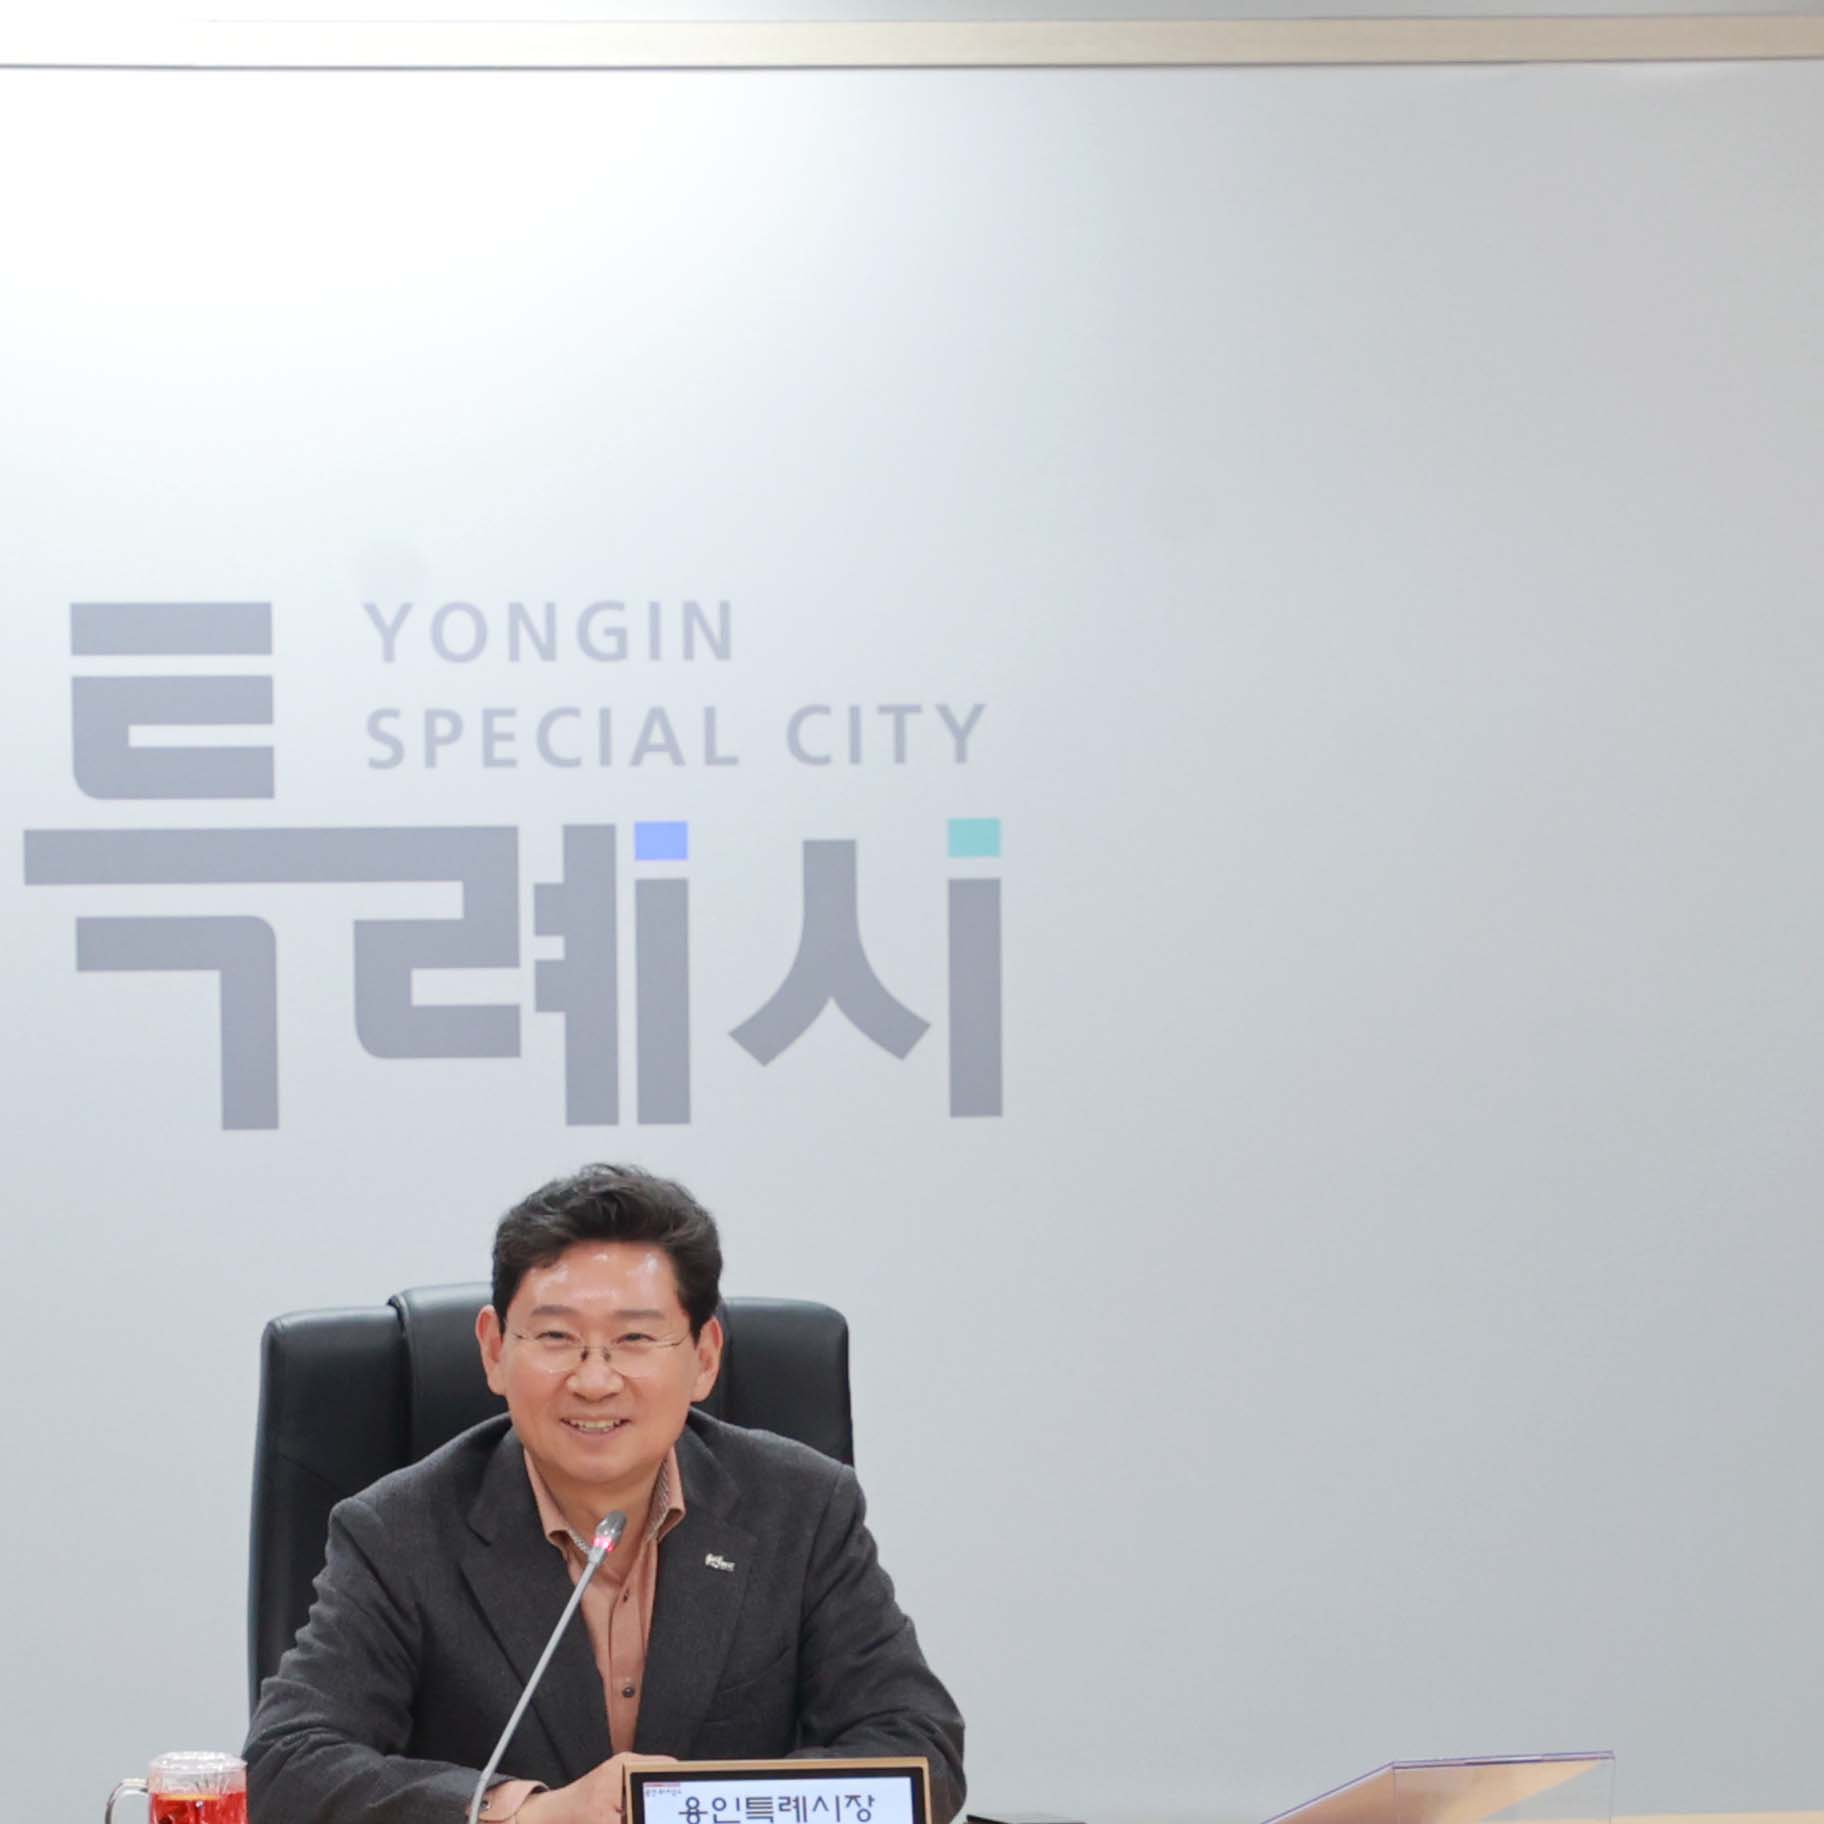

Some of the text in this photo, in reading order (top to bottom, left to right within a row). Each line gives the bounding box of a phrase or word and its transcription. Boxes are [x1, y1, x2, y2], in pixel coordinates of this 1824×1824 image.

[362, 599, 732, 664] YONGIN
[365, 703, 987, 770] SPECIAL CITY
